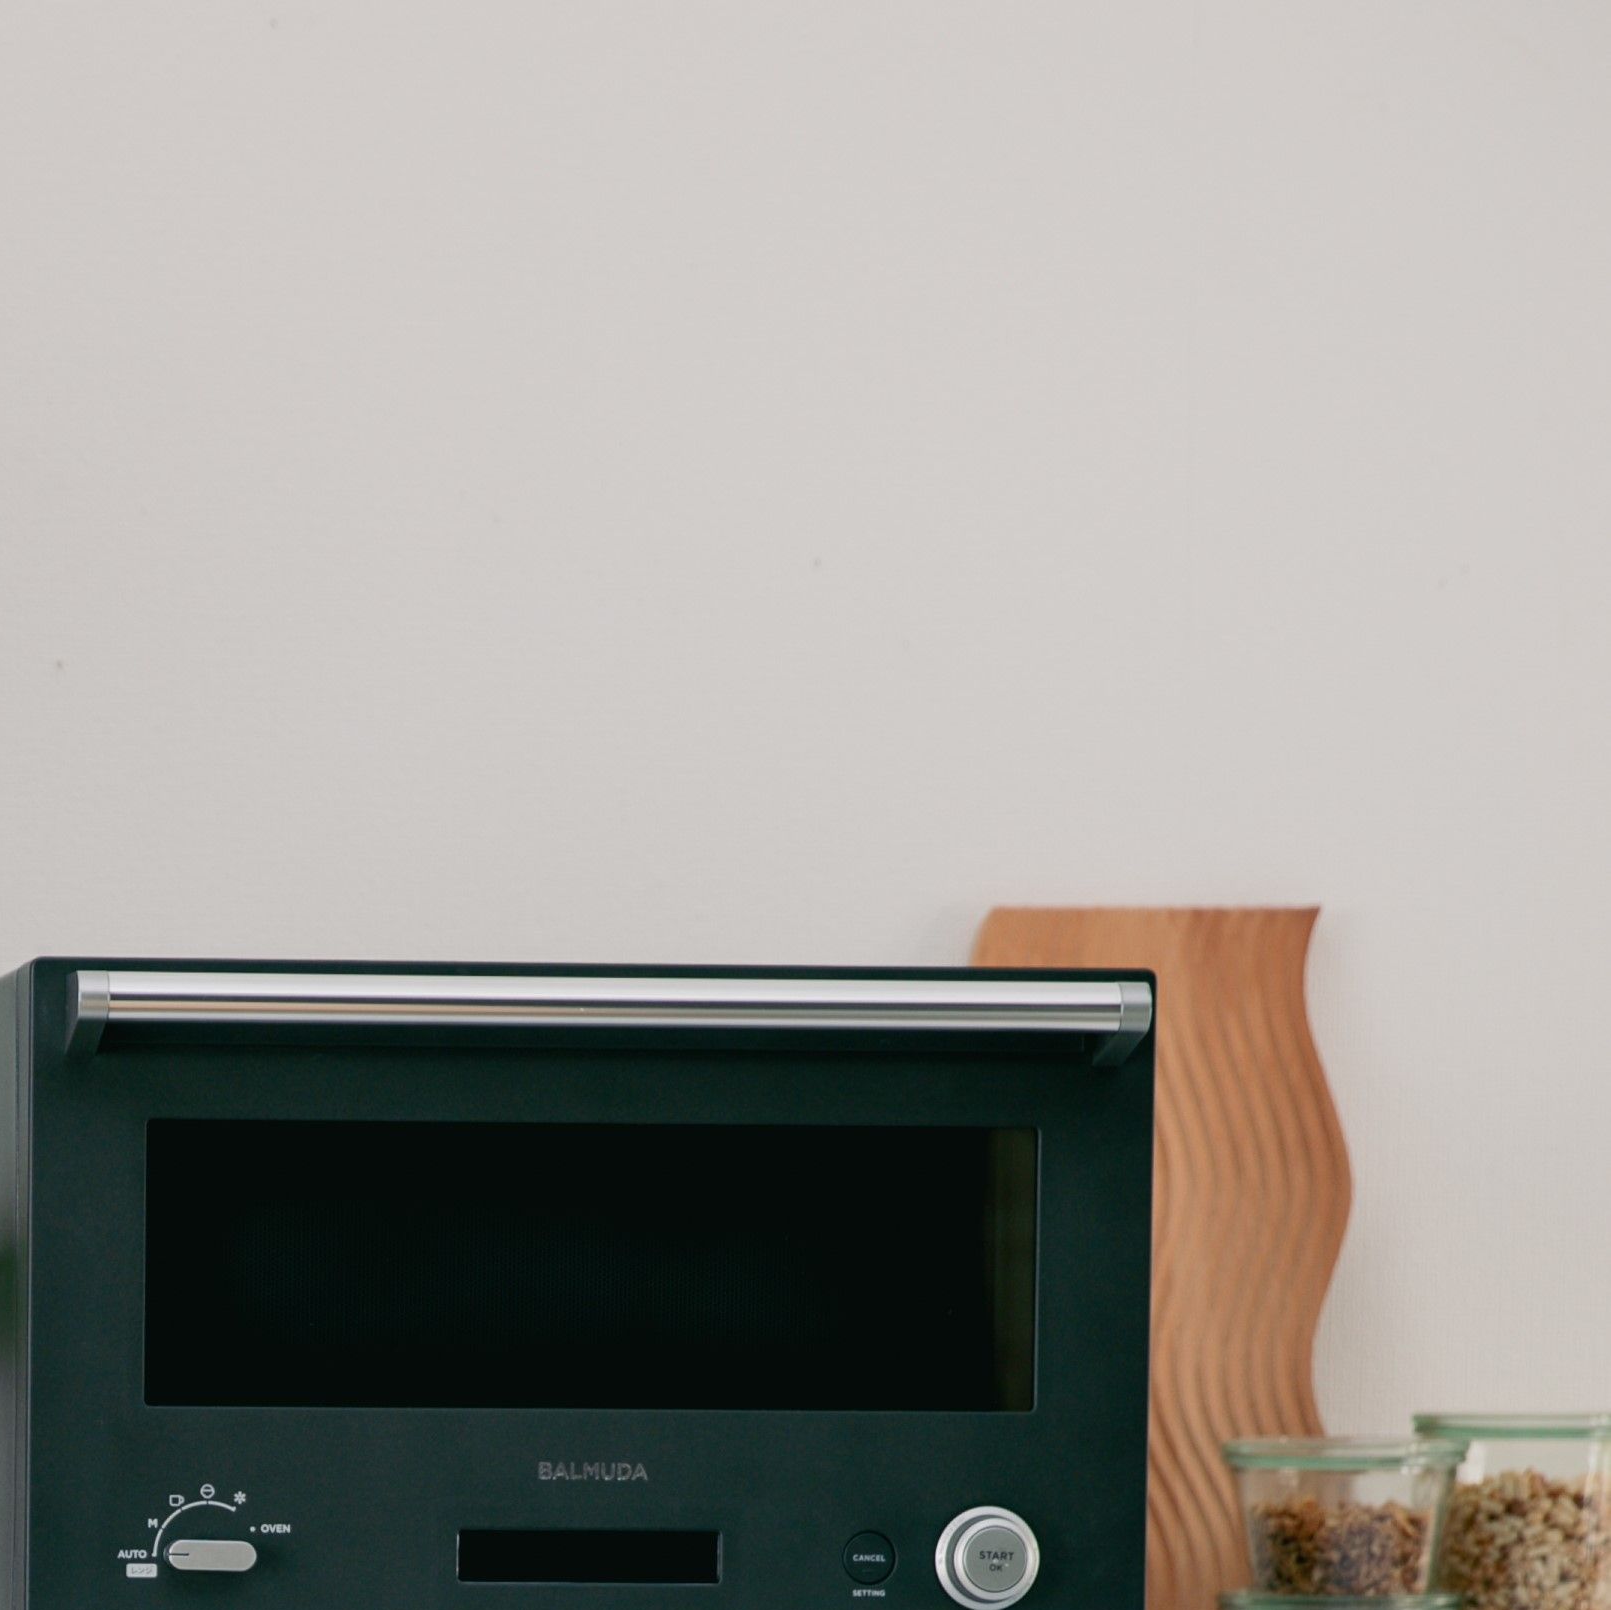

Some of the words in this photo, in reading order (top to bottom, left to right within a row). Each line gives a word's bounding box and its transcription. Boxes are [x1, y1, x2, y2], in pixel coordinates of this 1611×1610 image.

[538, 1461, 649, 1482] BALMUDA
[147, 1518, 158, 1528] M
[260, 1524, 291, 1533] OVEN
[117, 1549, 147, 1559] AUTO
[852, 1554, 886, 1563] CANCEL
[979, 1550, 1014, 1561] START
[989, 1563, 1003, 1572] OK
[852, 1589, 886, 1597] SETTING
